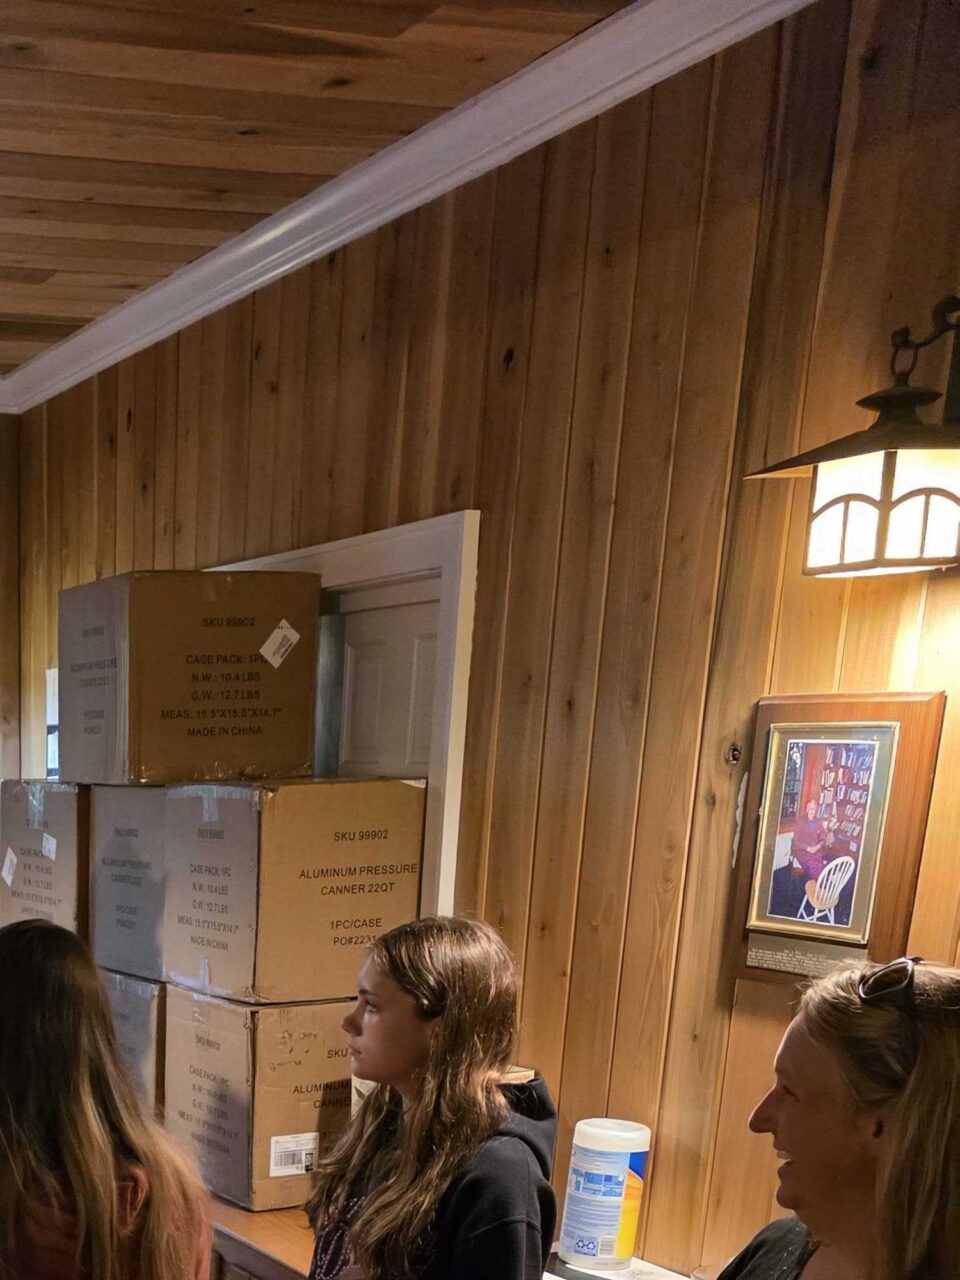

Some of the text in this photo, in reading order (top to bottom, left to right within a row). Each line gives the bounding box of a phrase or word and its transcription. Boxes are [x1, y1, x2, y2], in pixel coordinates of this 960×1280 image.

[202, 617, 256, 628] SKU 99902
[185, 654, 214, 664] CASE
[221, 672, 240, 682] 10.4
[242, 672, 261, 682] LBS
[220, 690, 240, 700] 12.7
[241, 690, 260, 700] LBS
[187, 726, 263, 737] MADE IN CHINA
[334, 830, 389, 842] SKU 99902
[190, 863, 204, 874] CASE
[298, 864, 418, 880] ALUMINUM PRESSURE
[321, 882, 396, 896] CANNER 22QT
[330, 918, 382, 930] 1PC/CASE
[326, 1049, 348, 1060] SKU
[292, 1082, 350, 1094] ALUMINUM
[314, 1098, 350, 1110] CANNE
